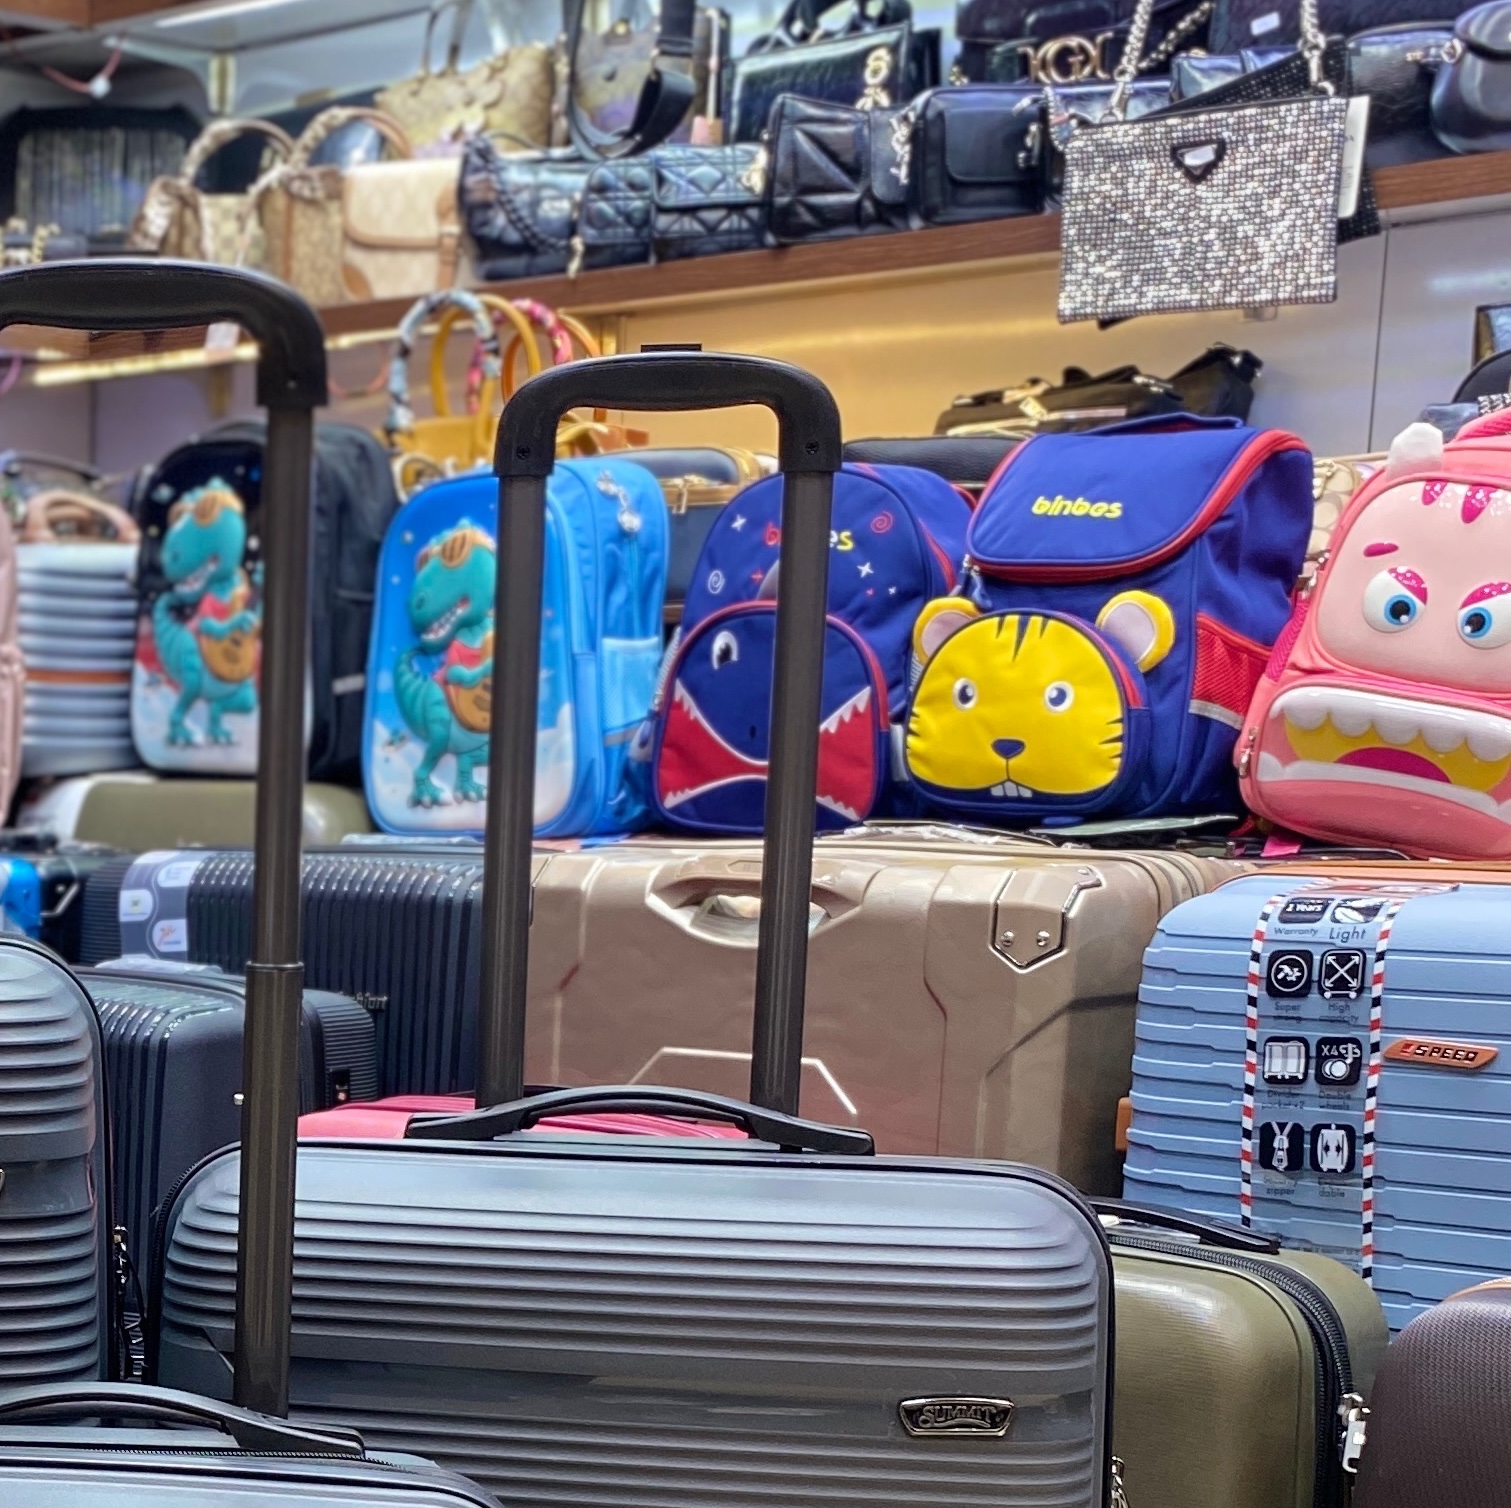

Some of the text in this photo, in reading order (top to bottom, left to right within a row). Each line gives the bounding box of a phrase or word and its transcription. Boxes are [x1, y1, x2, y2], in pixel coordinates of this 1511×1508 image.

[1031, 495, 1123, 518] binbes
[1274, 927, 1318, 937] Warranty
[1329, 926, 1366, 943] Light
[1329, 1003, 1351, 1014] High
[1321, 1044, 1338, 1056] X4
[1414, 1045, 1478, 1061] SPEED
[919, 1405, 997, 1428] SUMMIT
